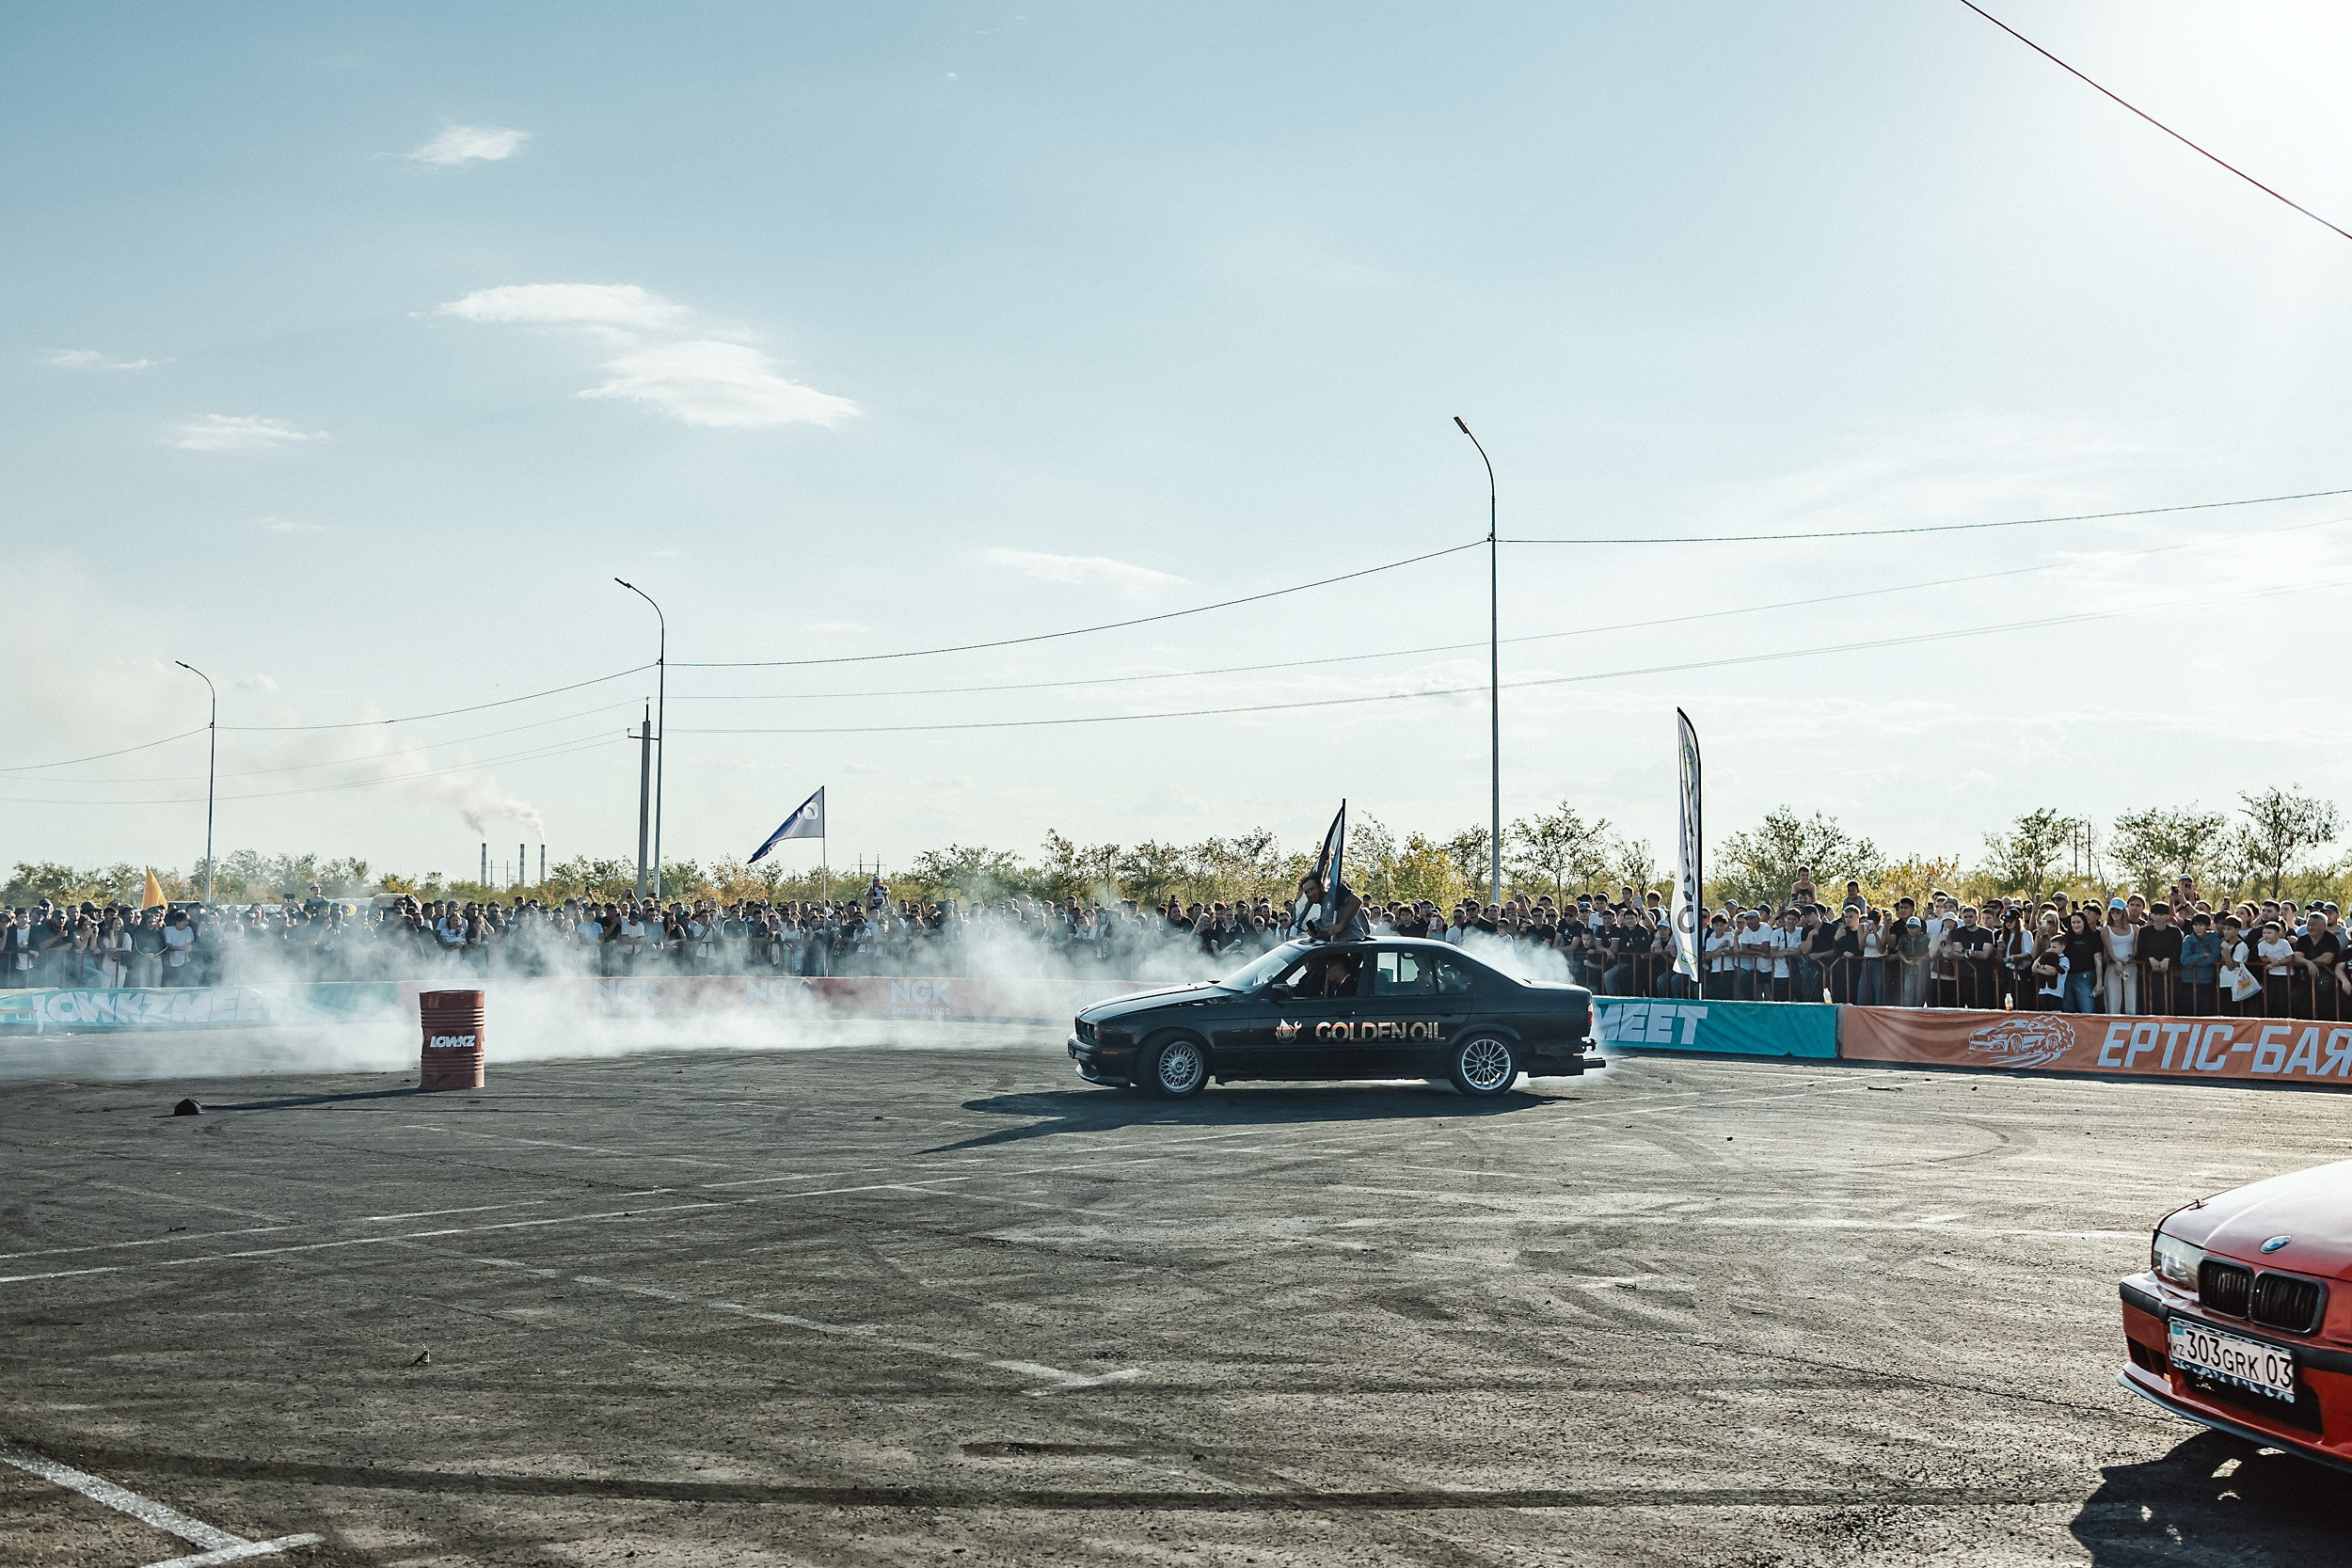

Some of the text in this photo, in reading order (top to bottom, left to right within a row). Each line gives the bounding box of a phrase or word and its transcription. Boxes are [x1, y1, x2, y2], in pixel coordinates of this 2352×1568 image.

[594, 979, 662, 1004] NGK
[746, 978, 792, 1003] NG
[890, 979, 951, 1006] NGK
[32, 989, 278, 1023] LOWKZMEE
[922, 1007, 951, 1016] PLUGS
[429, 1035, 476, 1048] LOWKZ
[1315, 1022, 1446, 1042] GOLDEN OIL
[2097, 1022, 2352, 1077] ЕРТІС-БАЯ
[2265, 1354, 2292, 1388] 03
